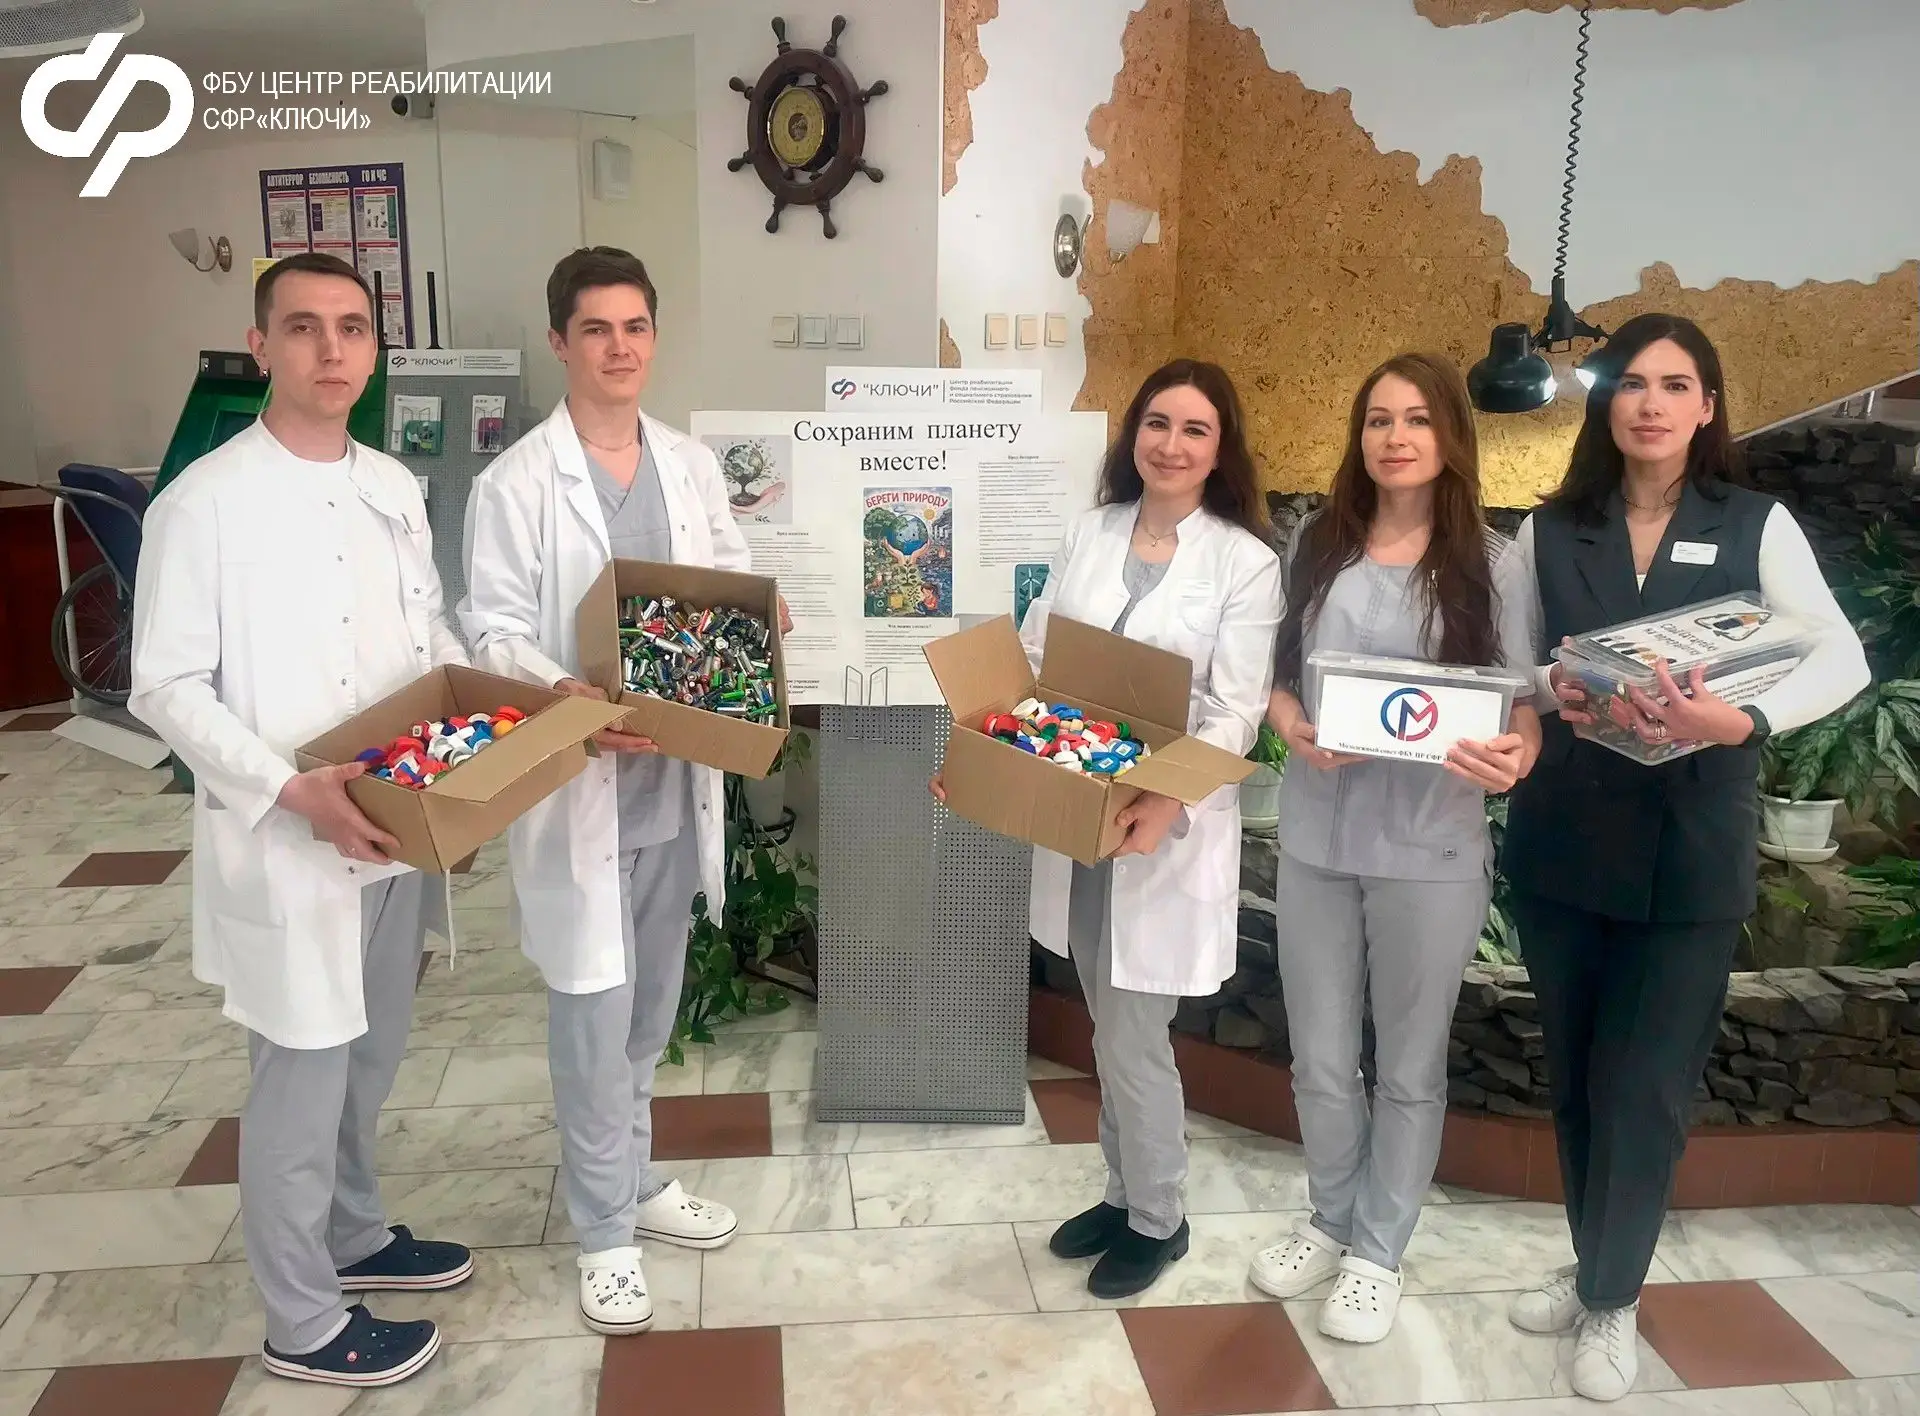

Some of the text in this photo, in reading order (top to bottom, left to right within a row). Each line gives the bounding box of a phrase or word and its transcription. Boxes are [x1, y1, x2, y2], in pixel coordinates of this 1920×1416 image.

[267, 174, 304, 187] АНТИТЕРРОР
[308, 171, 350, 185] БЕЗОПАСНОСТЬ
[361, 170, 370, 183] ГО
[377, 169, 387, 182] ЧС
[793, 420, 1022, 447] Сохраним планету
[860, 450, 948, 471] вместе!
[866, 492, 949, 508] БЕРЕГИ ПРИРОДУ
